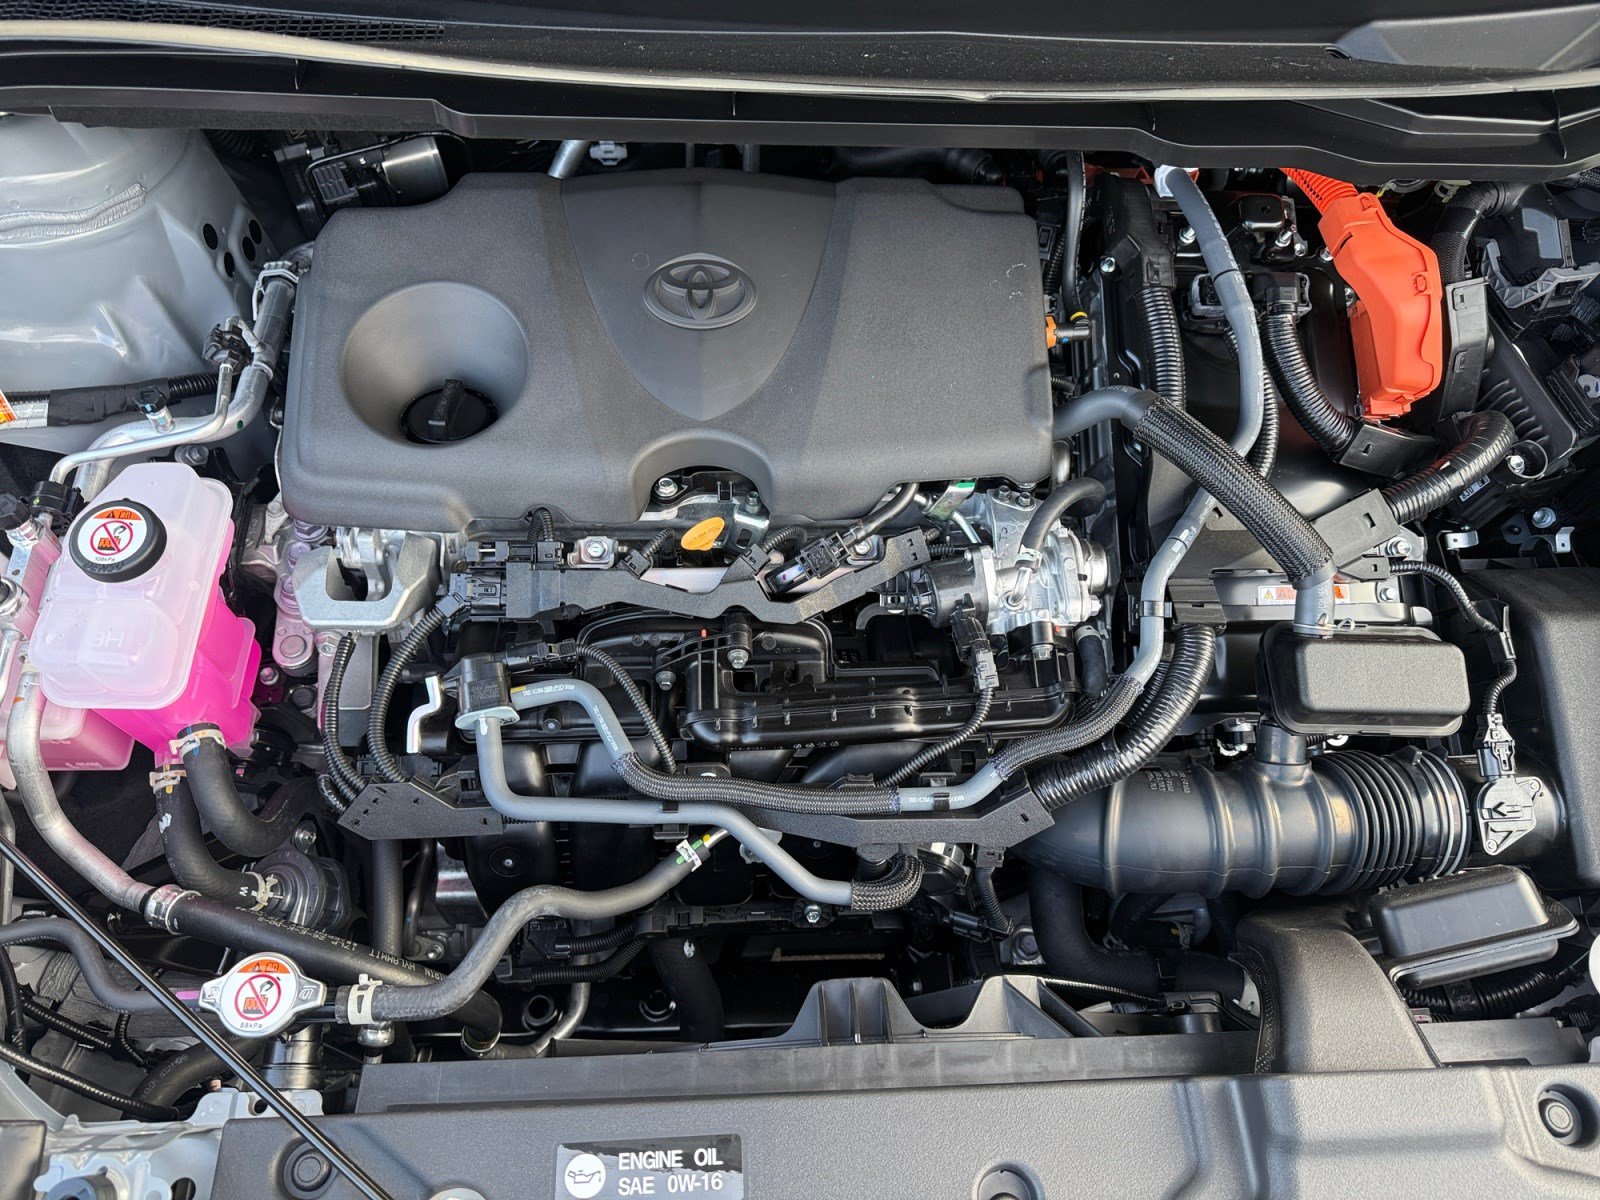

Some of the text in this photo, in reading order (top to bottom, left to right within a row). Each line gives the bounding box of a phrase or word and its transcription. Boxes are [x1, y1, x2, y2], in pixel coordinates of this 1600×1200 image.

[240, 1021, 263, 1030] 88kPa
[618, 1148, 724, 1171] ENGINE OIL
[618, 1173, 723, 1196] SAE 0W-16
